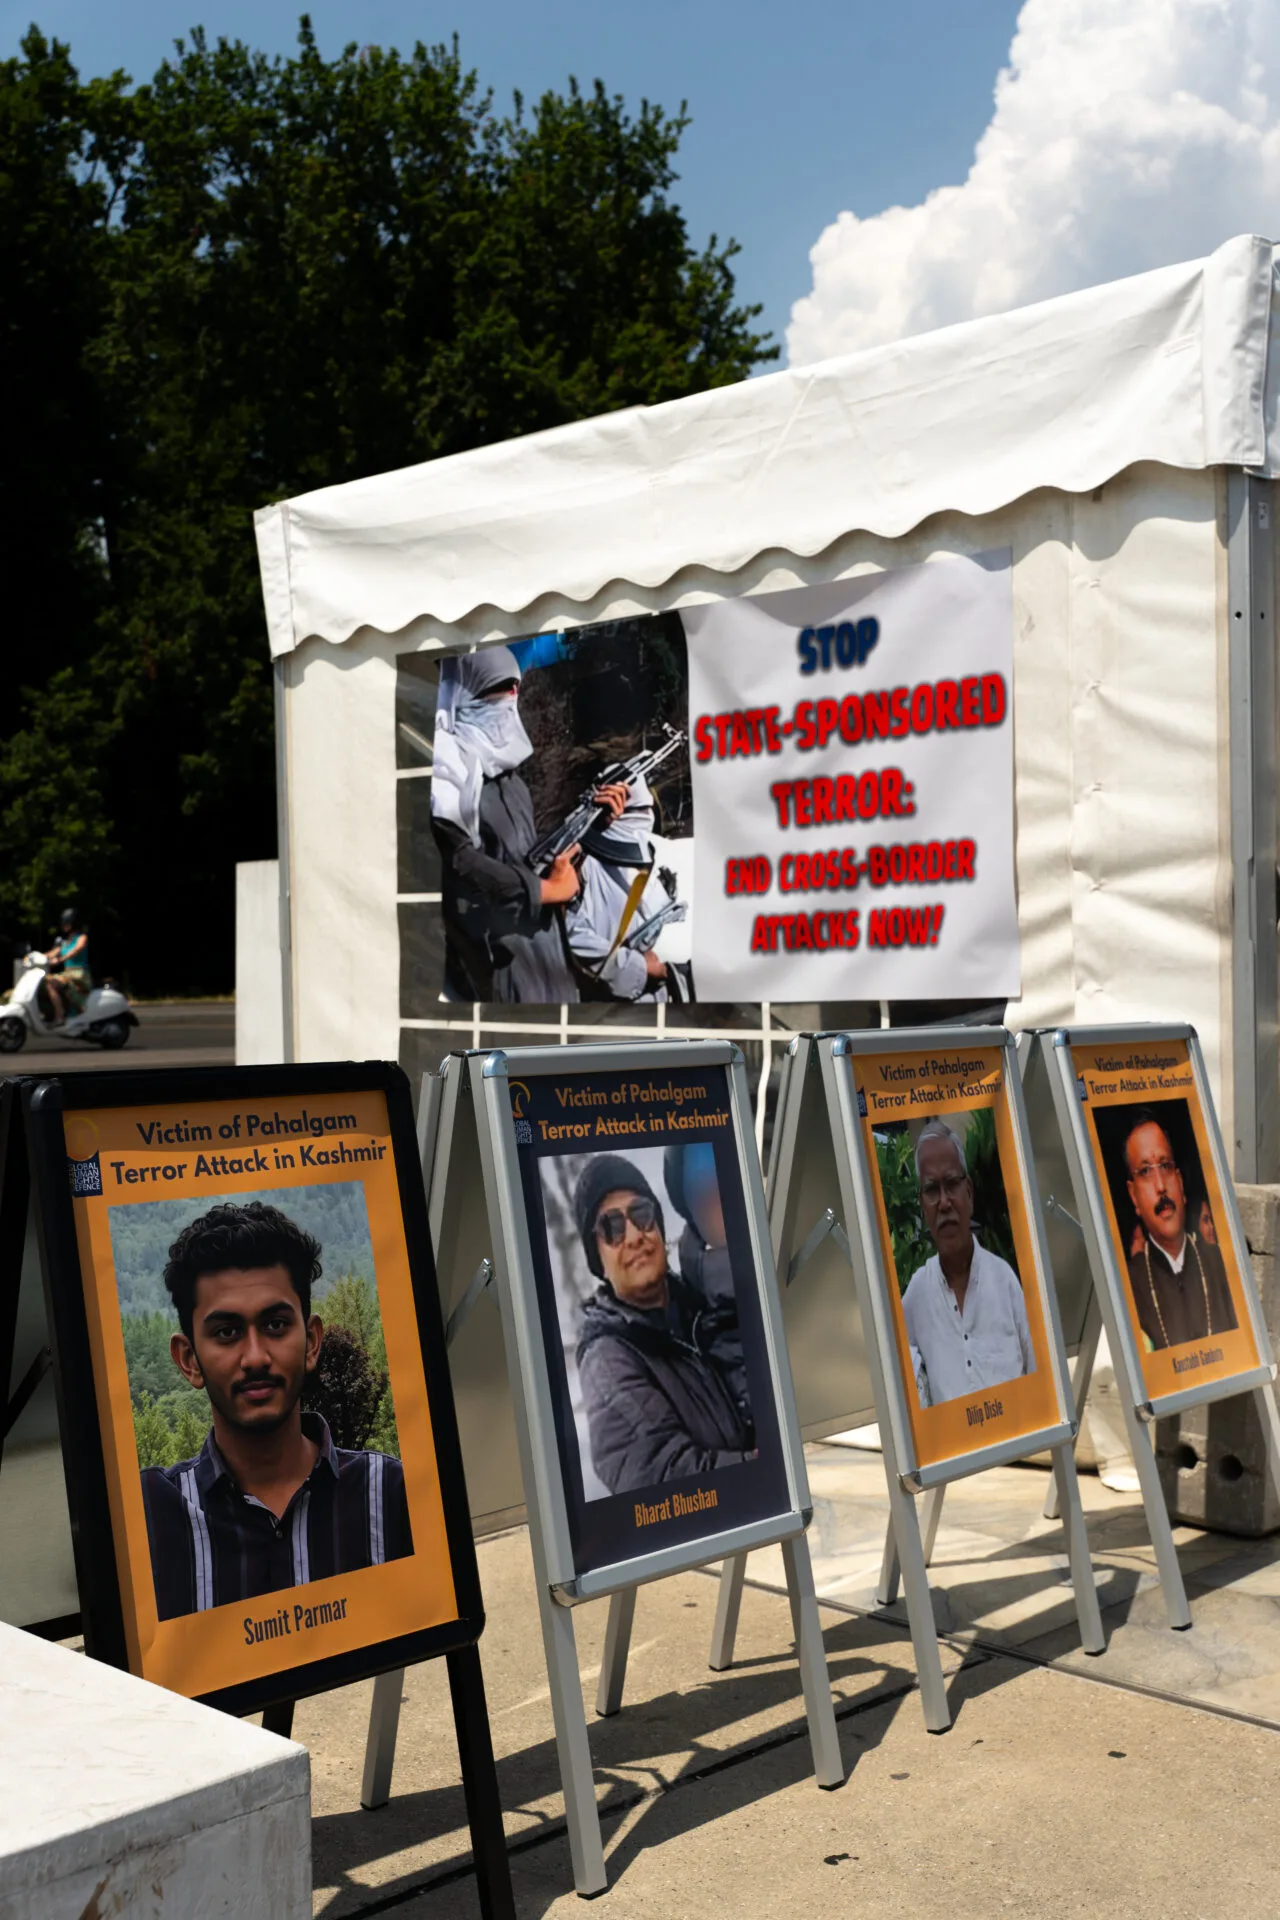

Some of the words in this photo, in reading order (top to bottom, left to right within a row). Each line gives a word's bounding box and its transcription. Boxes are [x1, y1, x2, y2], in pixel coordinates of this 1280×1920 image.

[798, 617, 879, 673] STOP
[695, 674, 1006, 762] STATE-SPONSORED
[771, 768, 915, 828] TERROR:
[725, 855, 771, 895] END
[779, 839, 977, 892] CROSS-BORDER
[751, 909, 860, 952] ATTACKS
[868, 905, 945, 947] NOW!
[879, 1064, 916, 1081] Victim
[918, 1060, 931, 1077] of
[931, 1057, 985, 1077] Pahalgam
[1094, 1055, 1123, 1072] Victim
[1126, 1055, 1134, 1069] of
[1134, 1053, 1178, 1070] Pahalgam
[554, 1086, 607, 1108] Victim
[611, 1083, 626, 1104] of
[630, 1081, 707, 1106] Pahalgam
[870, 1092, 906, 1109] Terror
[909, 1084, 945, 1104] Attack
[946, 1083, 957, 1099] in
[958, 1078, 1002, 1097] Kashmir
[1088, 1080, 1117, 1095] Terror
[1120, 1076, 1148, 1092] Attack
[1148, 1076, 1157, 1089] in
[1157, 1073, 1193, 1089] Kashmir
[136, 1119, 212, 1145] Victim
[218, 1115, 241, 1139] of
[246, 1110, 357, 1137] Pahalgam
[538, 1119, 592, 1140] Terror
[595, 1112, 648, 1136] Attack
[650, 1113, 664, 1132] in
[666, 1108, 730, 1131] Kashmir
[71, 1162, 98, 1172] LOBAL
[72, 1169, 99, 1179] UMAN
[110, 1161, 187, 1185] Terror
[194, 1149, 269, 1178] Attack
[274, 1148, 295, 1169] in
[299, 1139, 387, 1167] Kashmir
[73, 1176, 100, 1185] IGHTS
[74, 1183, 101, 1192] EFENCE
[634, 1498, 672, 1528] Bharat
[672, 1487, 719, 1518] Bhushan
[243, 1610, 291, 1645] Sumit
[293, 1598, 347, 1631] Parmar
